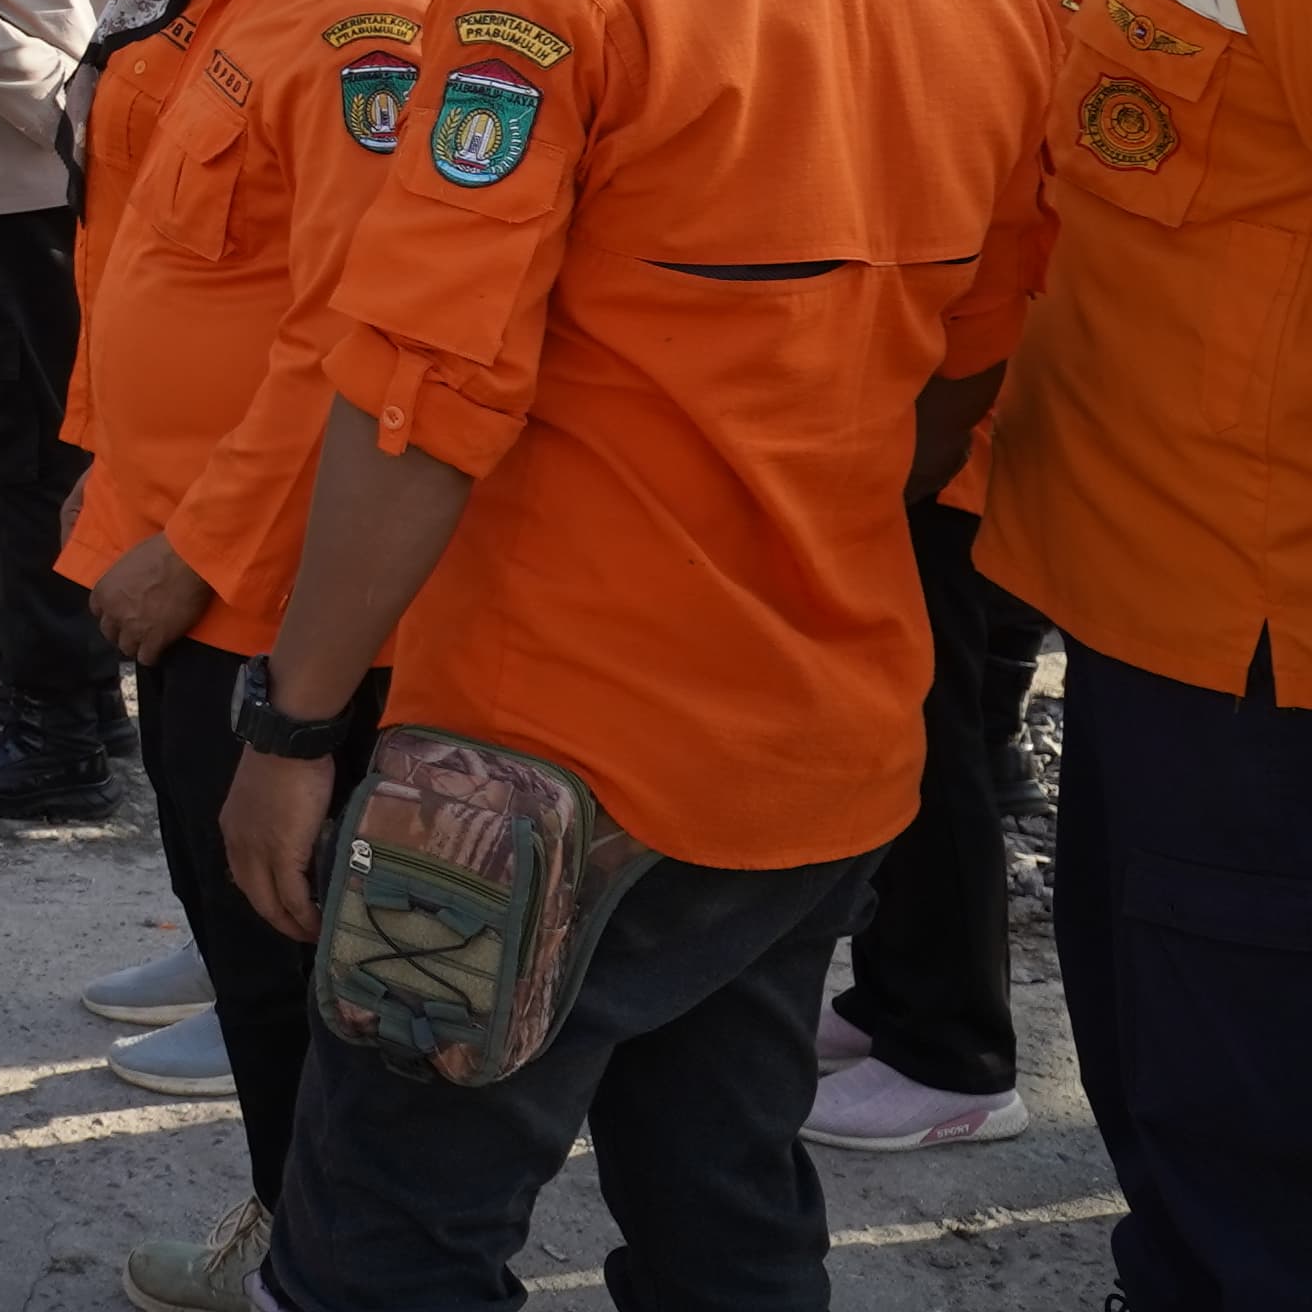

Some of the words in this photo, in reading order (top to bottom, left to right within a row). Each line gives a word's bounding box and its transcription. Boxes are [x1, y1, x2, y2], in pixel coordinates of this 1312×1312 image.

[326, 15, 387, 39] PEMERINTAH
[389, 17, 416, 32] KOTA
[335, 25, 408, 45] PRABUMULIH
[460, 13, 533, 37] PEMERINTAH
[534, 32, 563, 56] KOTA
[466, 27, 550, 62] PRABUMULIH
